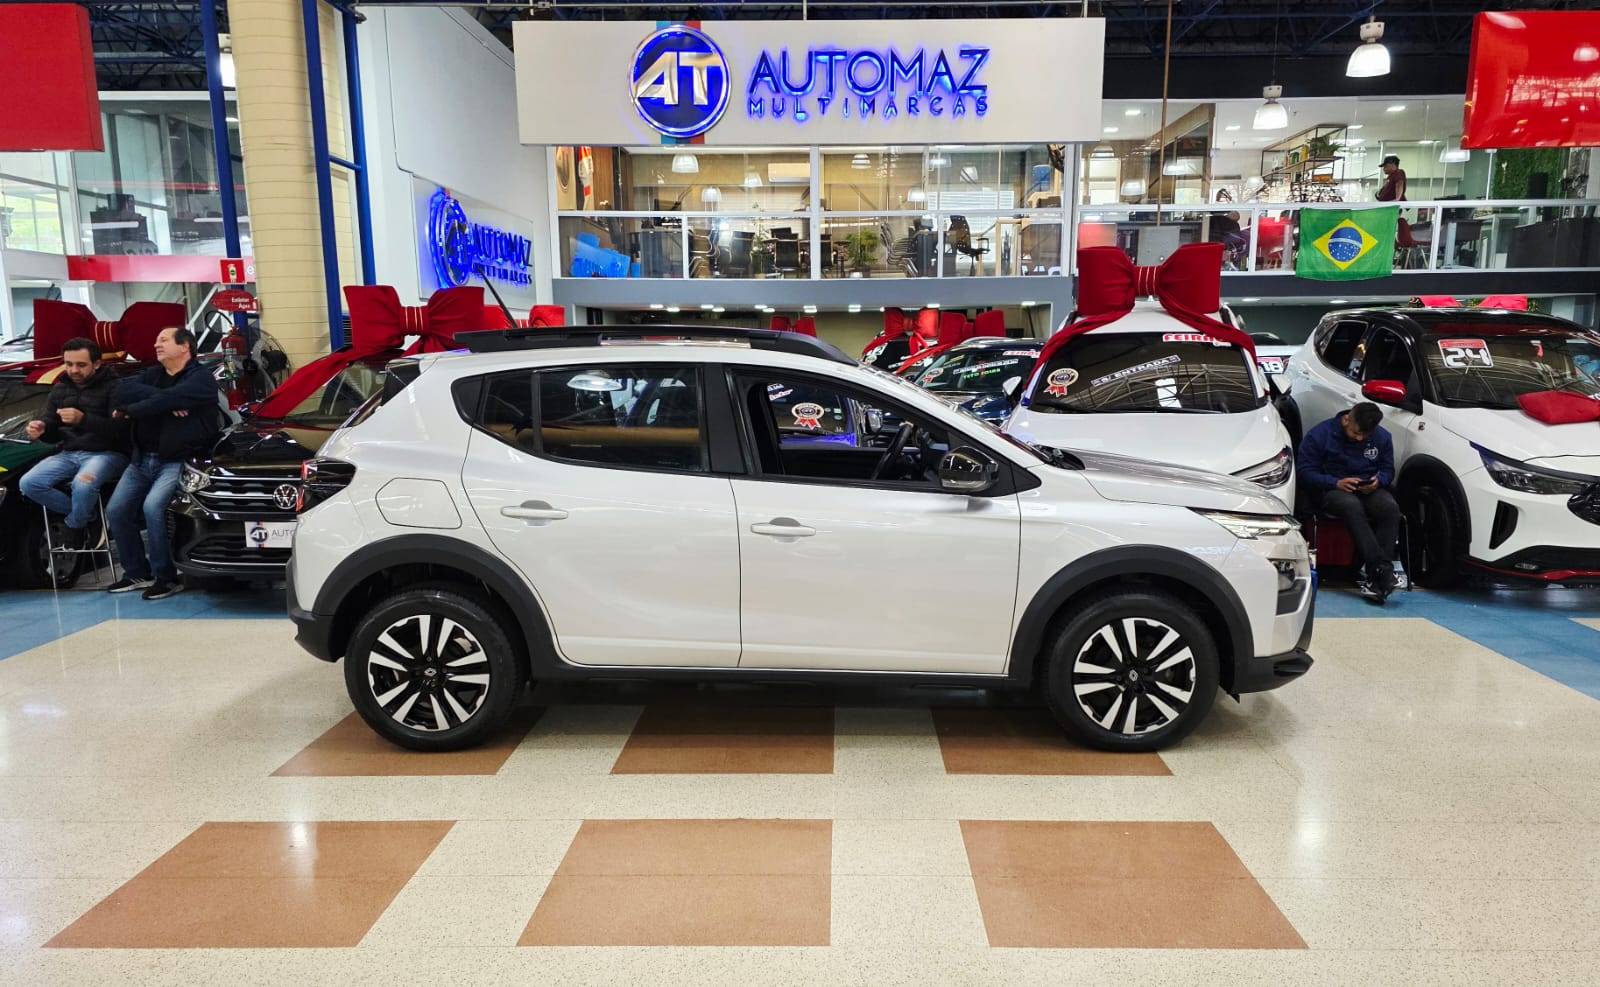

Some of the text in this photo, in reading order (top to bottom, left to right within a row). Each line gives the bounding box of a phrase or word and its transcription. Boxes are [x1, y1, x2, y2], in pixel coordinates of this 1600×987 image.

[634, 52, 721, 105] AT
[749, 49, 990, 95] AUTOMAZ
[749, 97, 988, 118] MULTIMARCAS
[1446, 348, 1491, 367] 24
